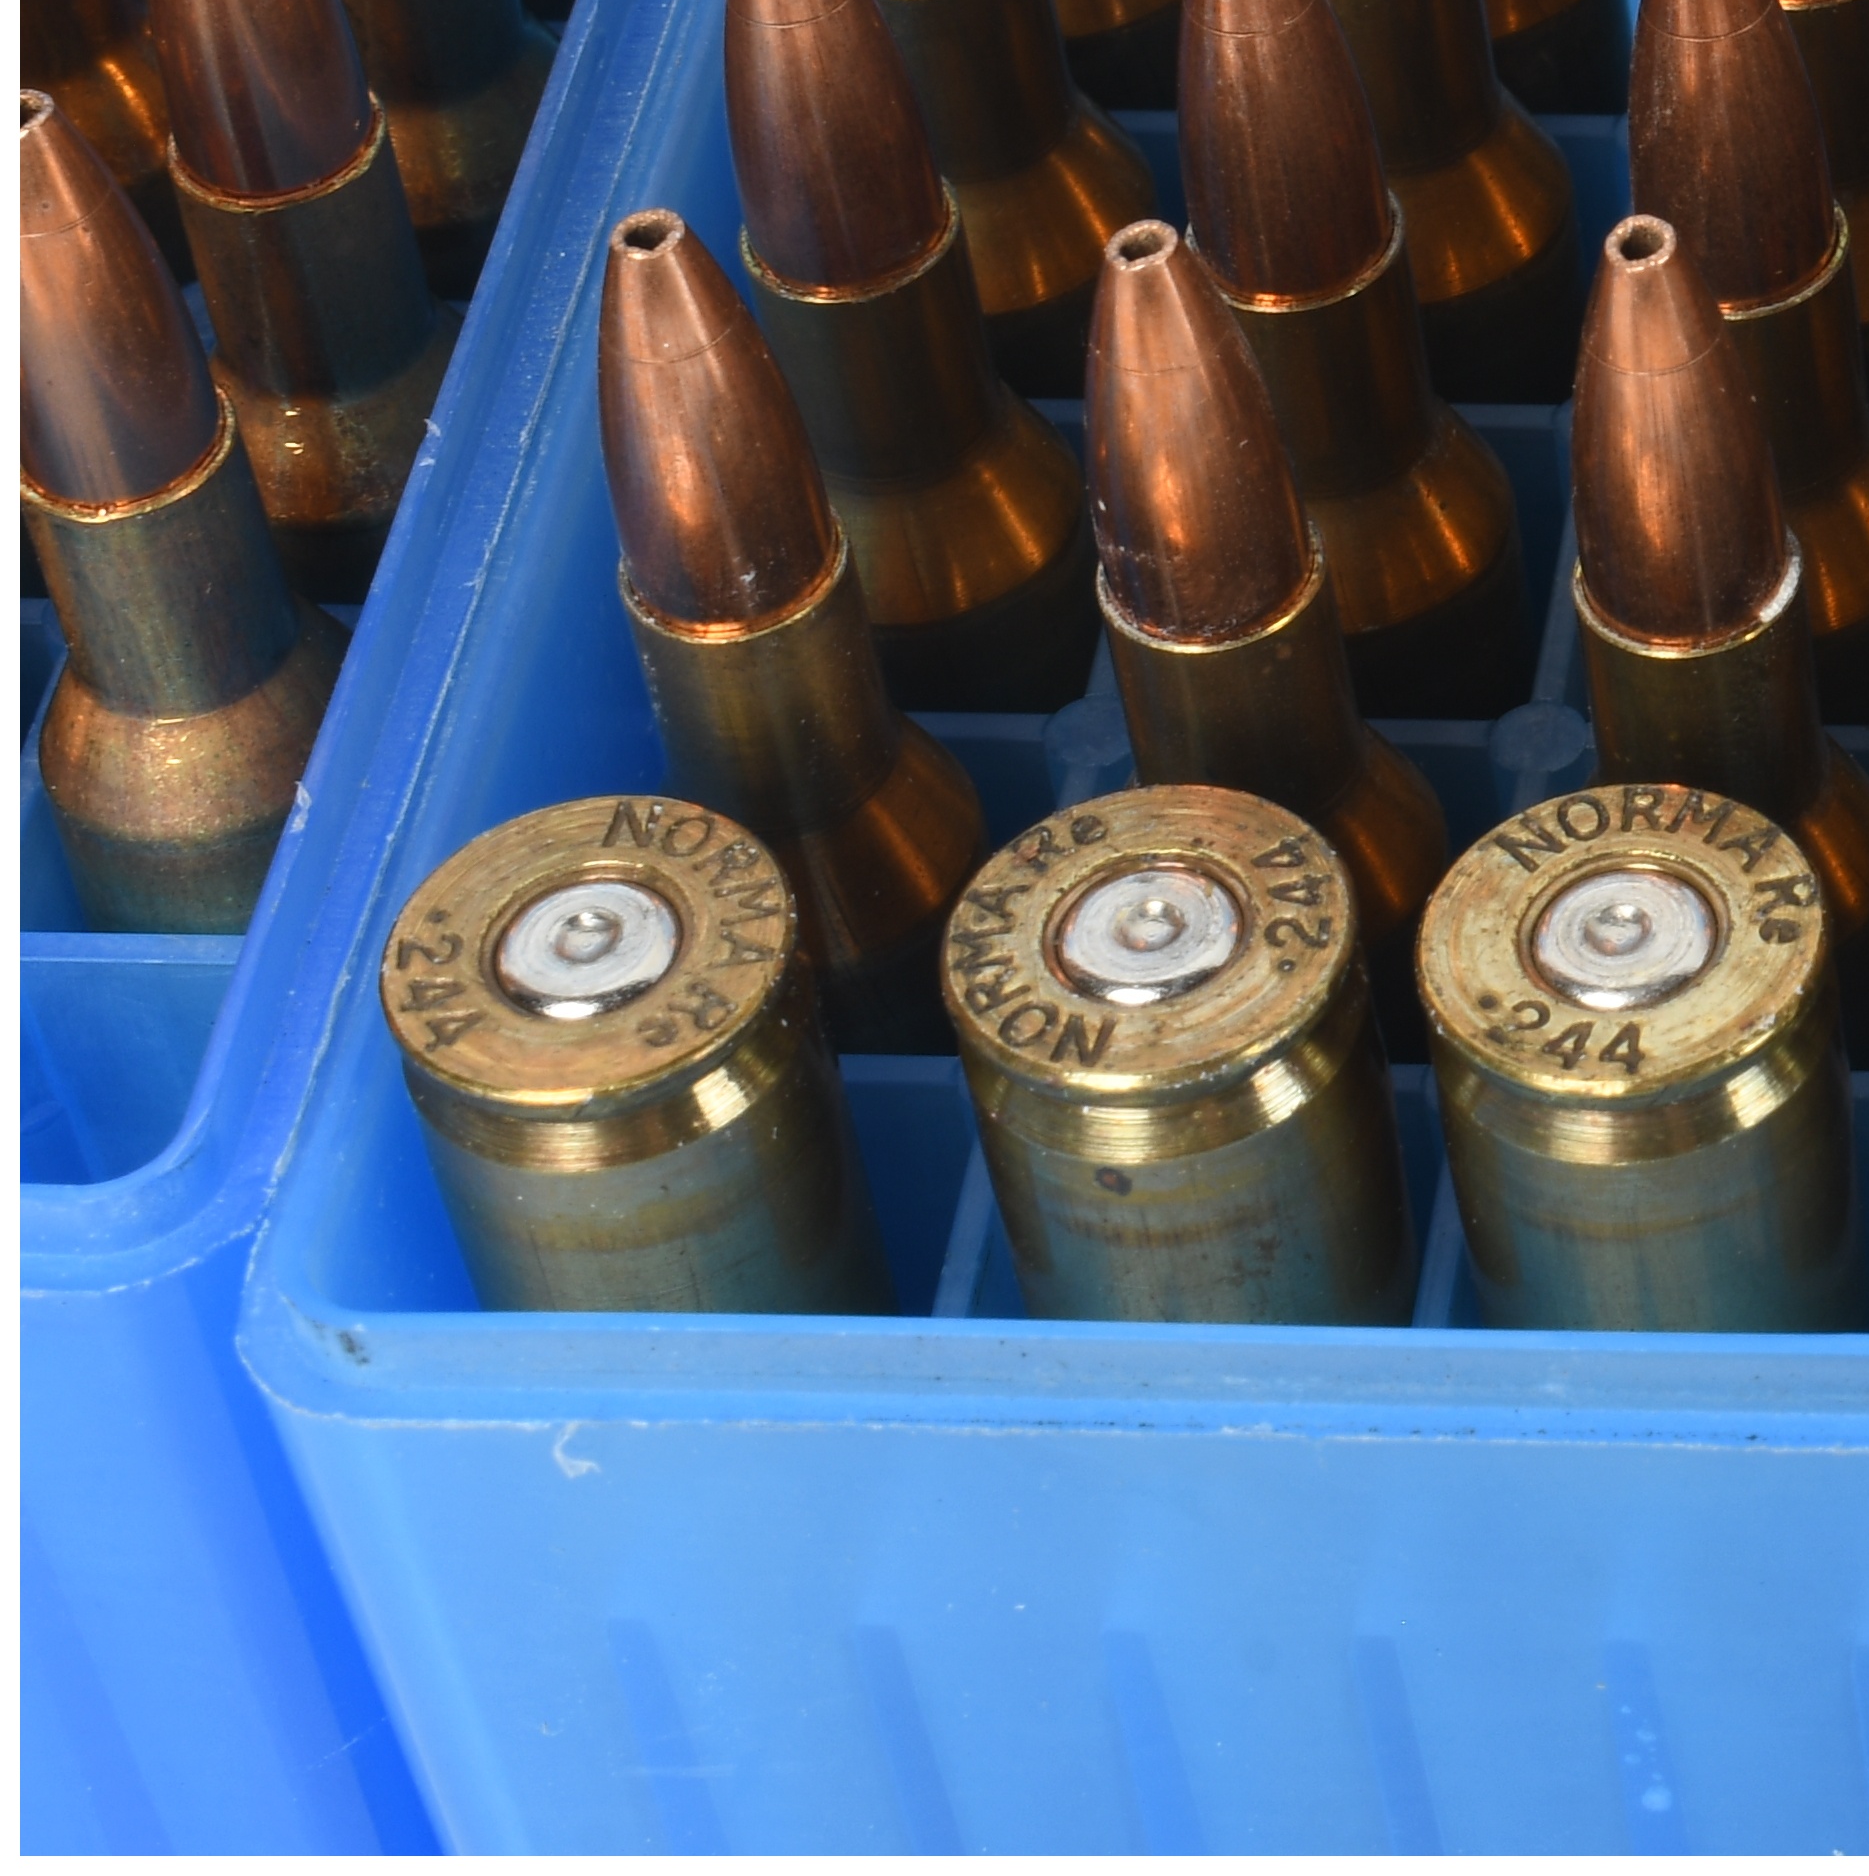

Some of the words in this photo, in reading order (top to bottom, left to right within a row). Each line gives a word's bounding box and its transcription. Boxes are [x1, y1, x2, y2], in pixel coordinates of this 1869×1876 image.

[600, 800, 782, 969] NORMA
[1490, 785, 1784, 874] NORMA
[1250, 830, 1334, 974] .244
[396, 908, 486, 1052] .244
[949, 883, 1118, 1069] NORMA
[1477, 992, 1648, 1076] .244
